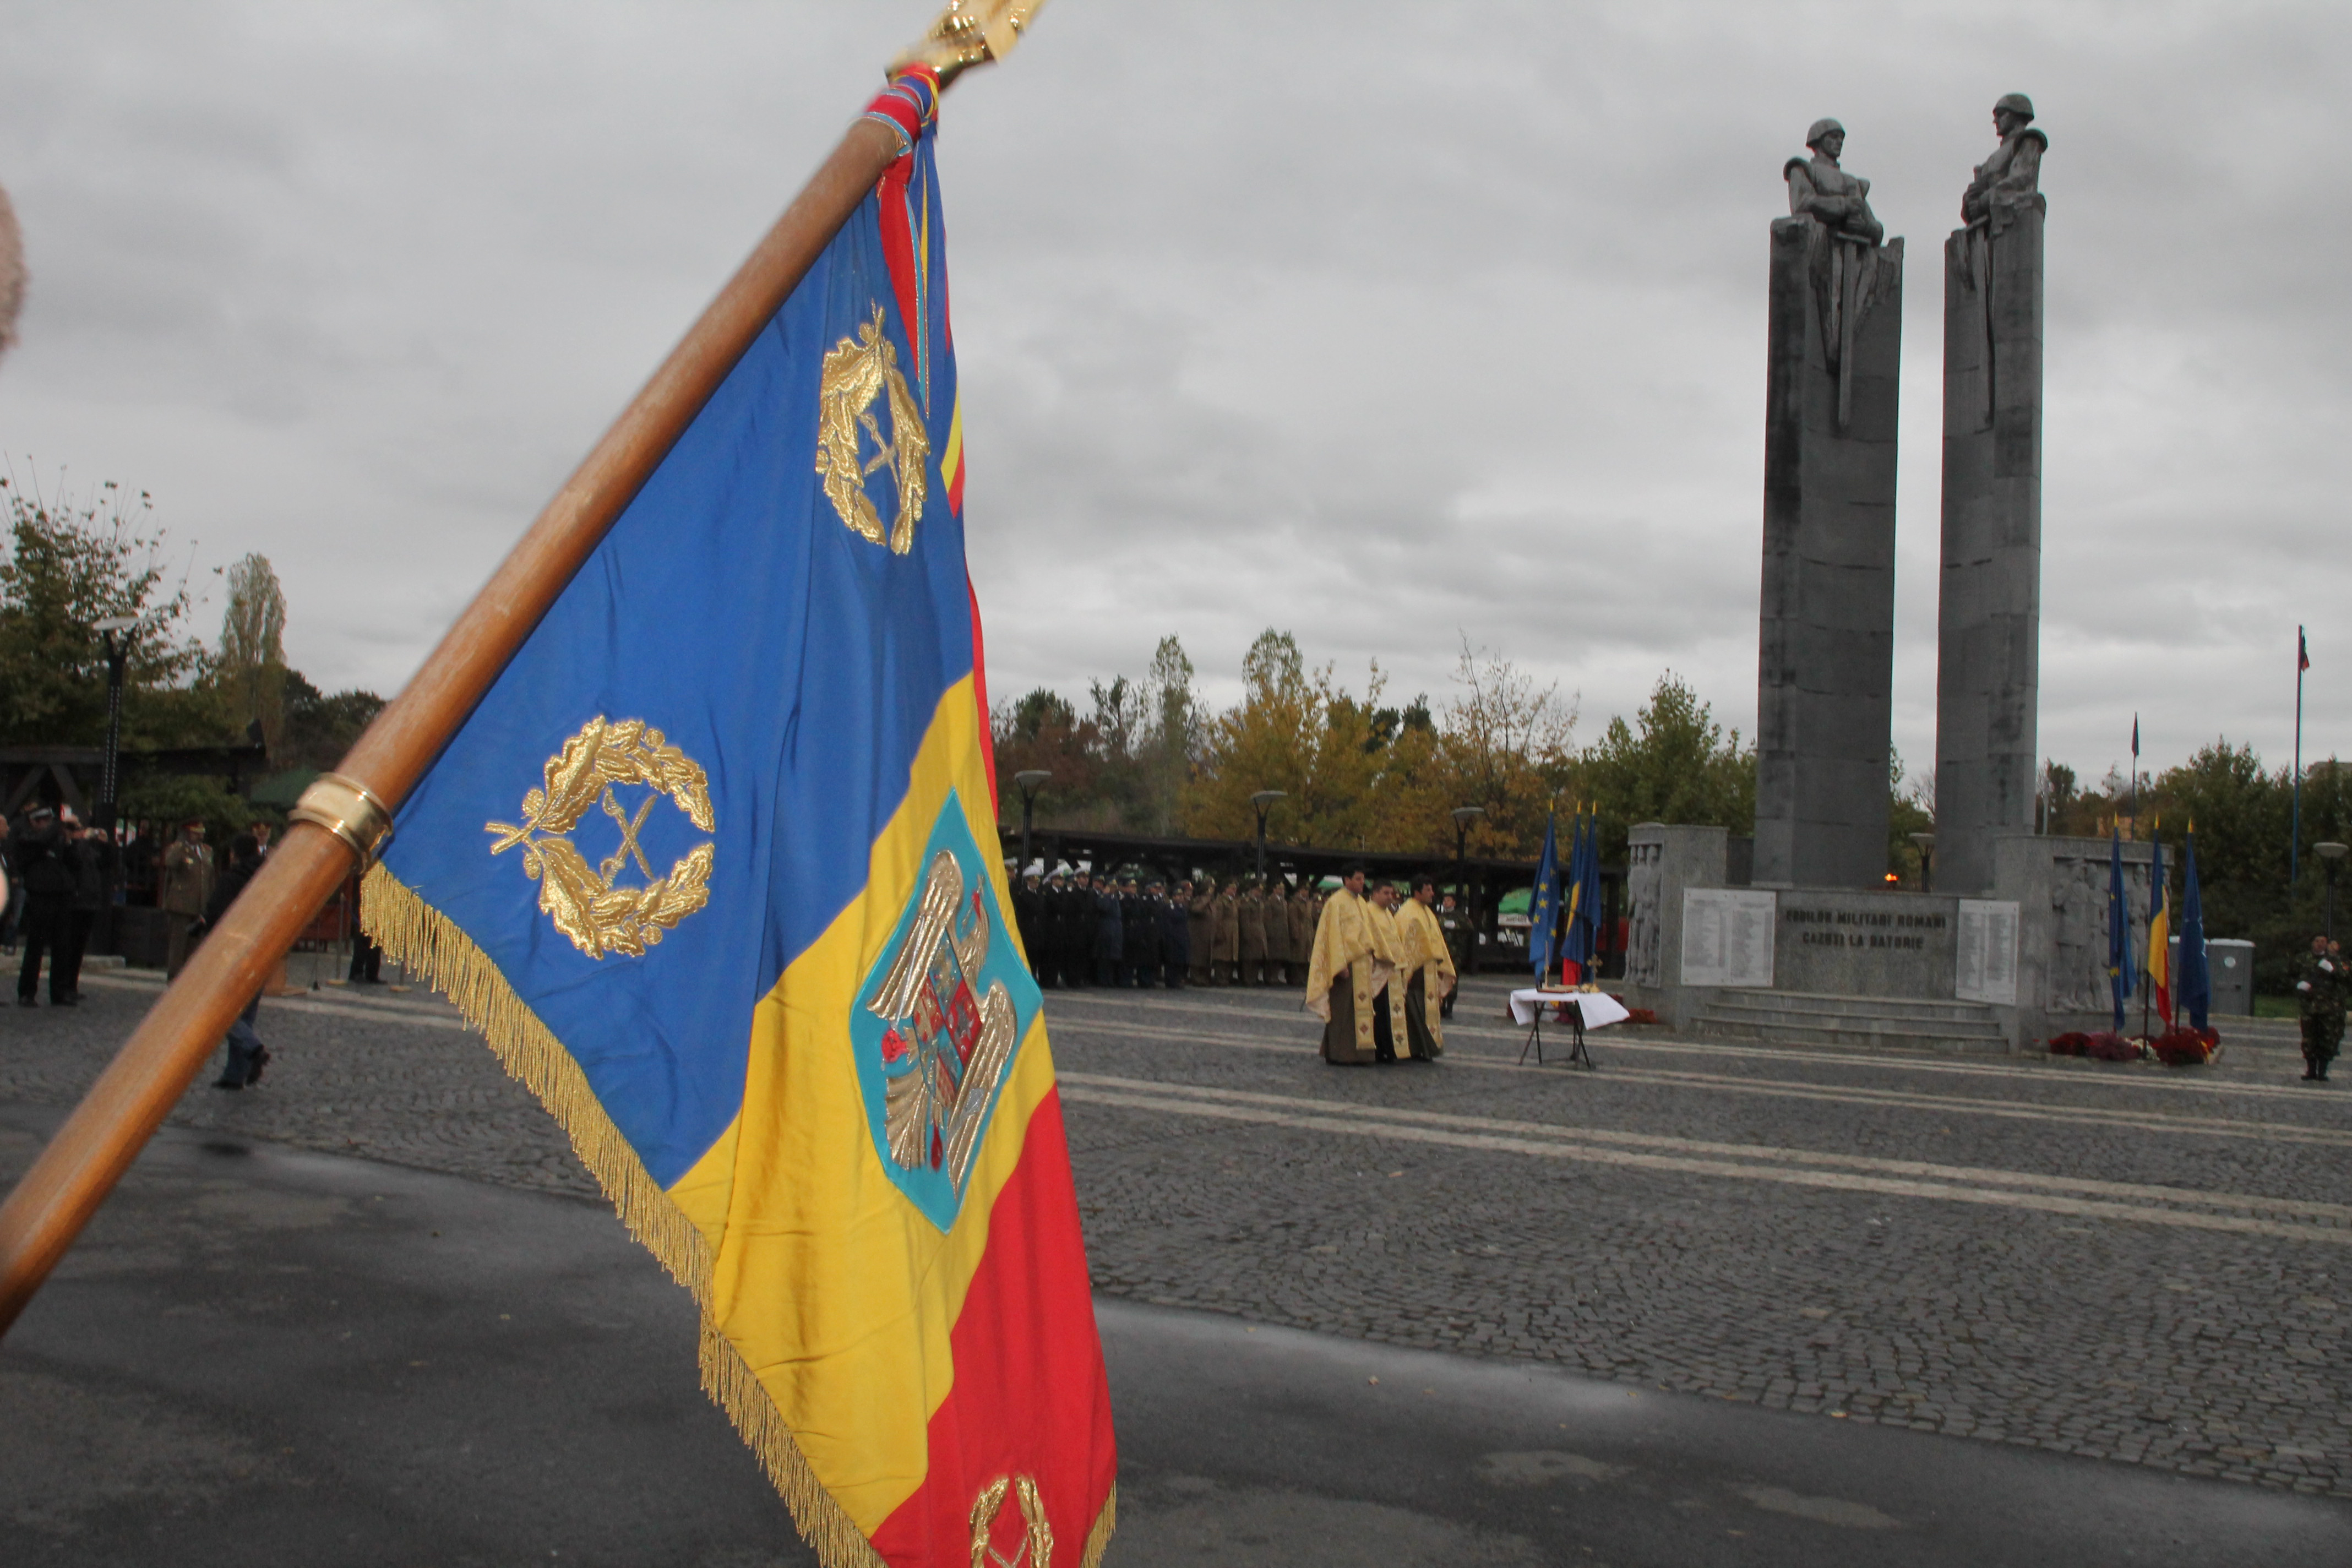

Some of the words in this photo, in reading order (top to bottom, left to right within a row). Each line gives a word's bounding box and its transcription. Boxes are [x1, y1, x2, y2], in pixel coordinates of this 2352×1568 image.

[1837, 912, 1892, 926] MILITARI
[1849, 934, 1864, 947] LA
[1870, 935, 1924, 950] DATORIE
